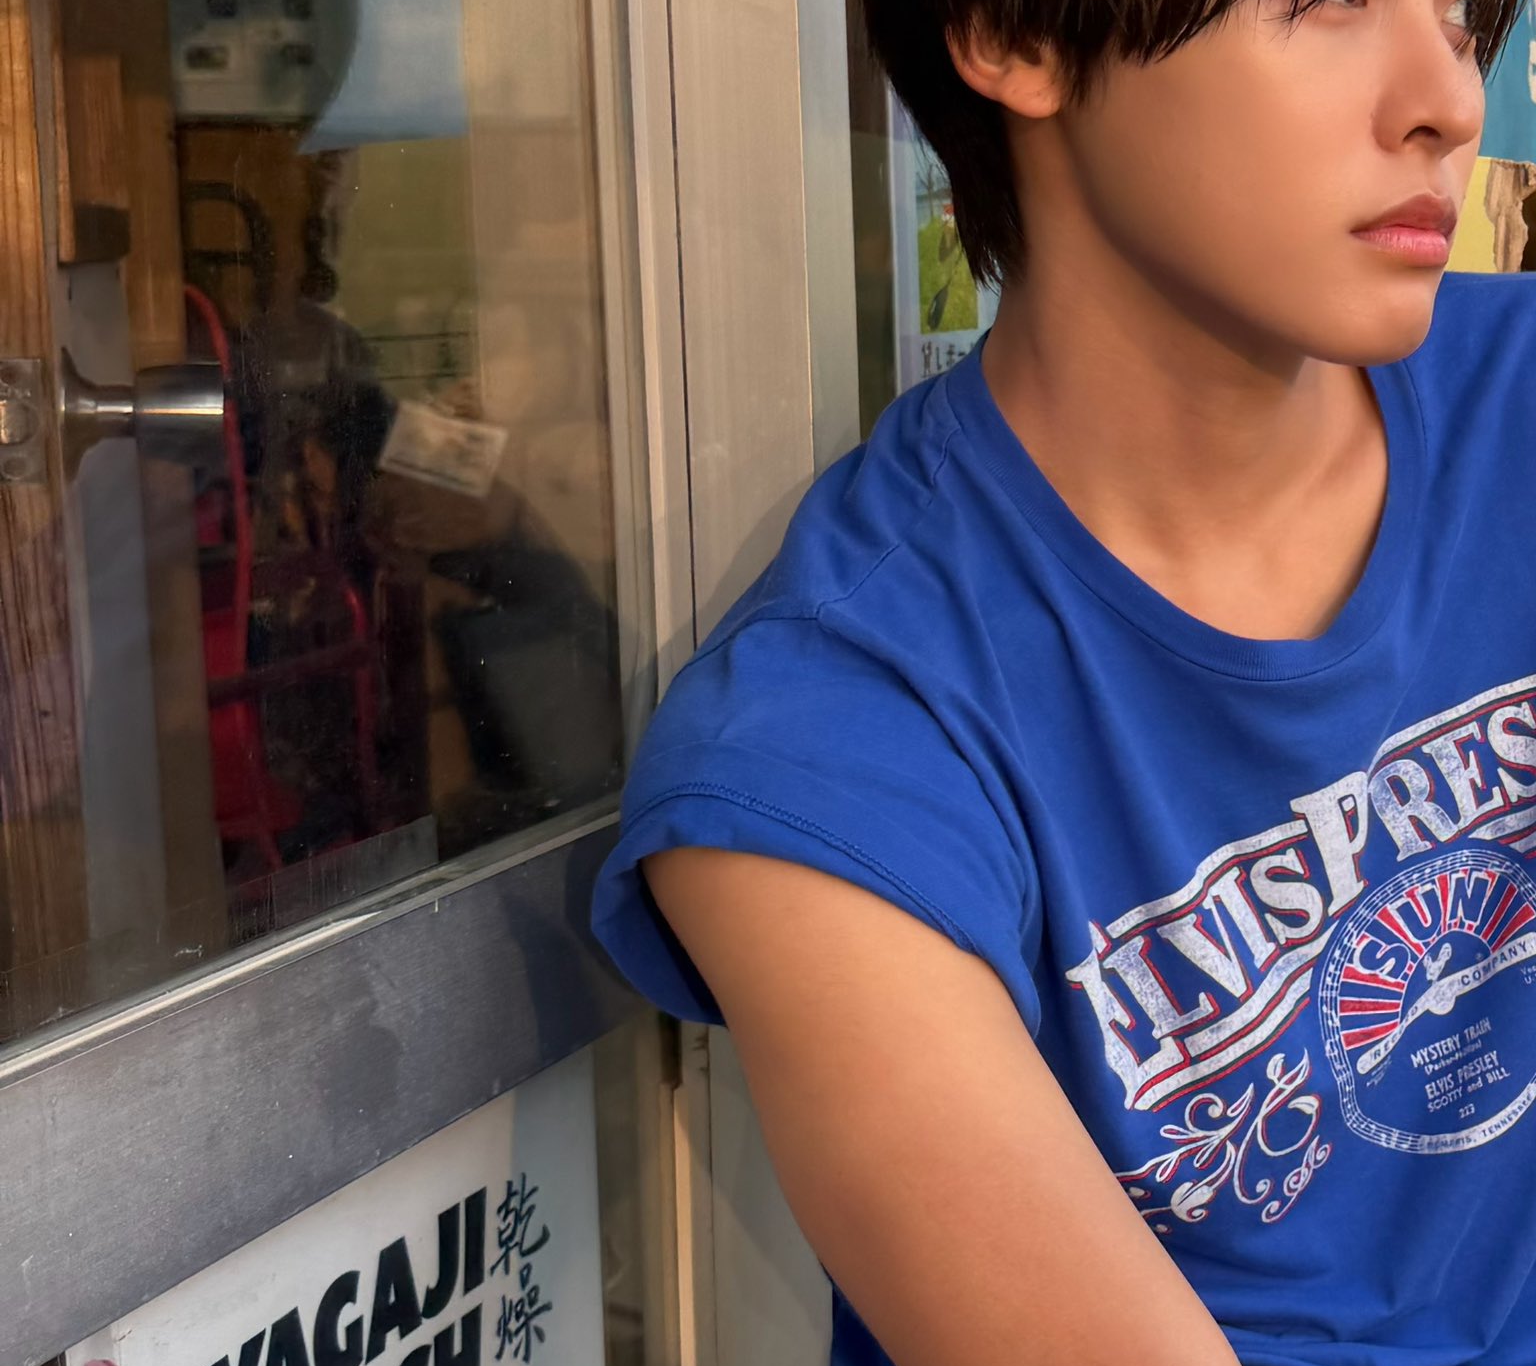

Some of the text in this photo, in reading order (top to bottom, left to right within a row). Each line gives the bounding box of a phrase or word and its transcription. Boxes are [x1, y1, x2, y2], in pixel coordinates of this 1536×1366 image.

[1352, 867, 1502, 984] SUN
[1065, 847, 1327, 1110] ELVIS
[1460, 942, 1528, 987] COMPANY
[1411, 1031, 1461, 1068] MYSTERY
[1425, 1050, 1500, 1101] ELVIS PRESLEY
[1427, 1089, 1463, 1113] SCOTTY
[1487, 1067, 1511, 1085] BILL
[490, 1172, 552, 1366] 乾燥
